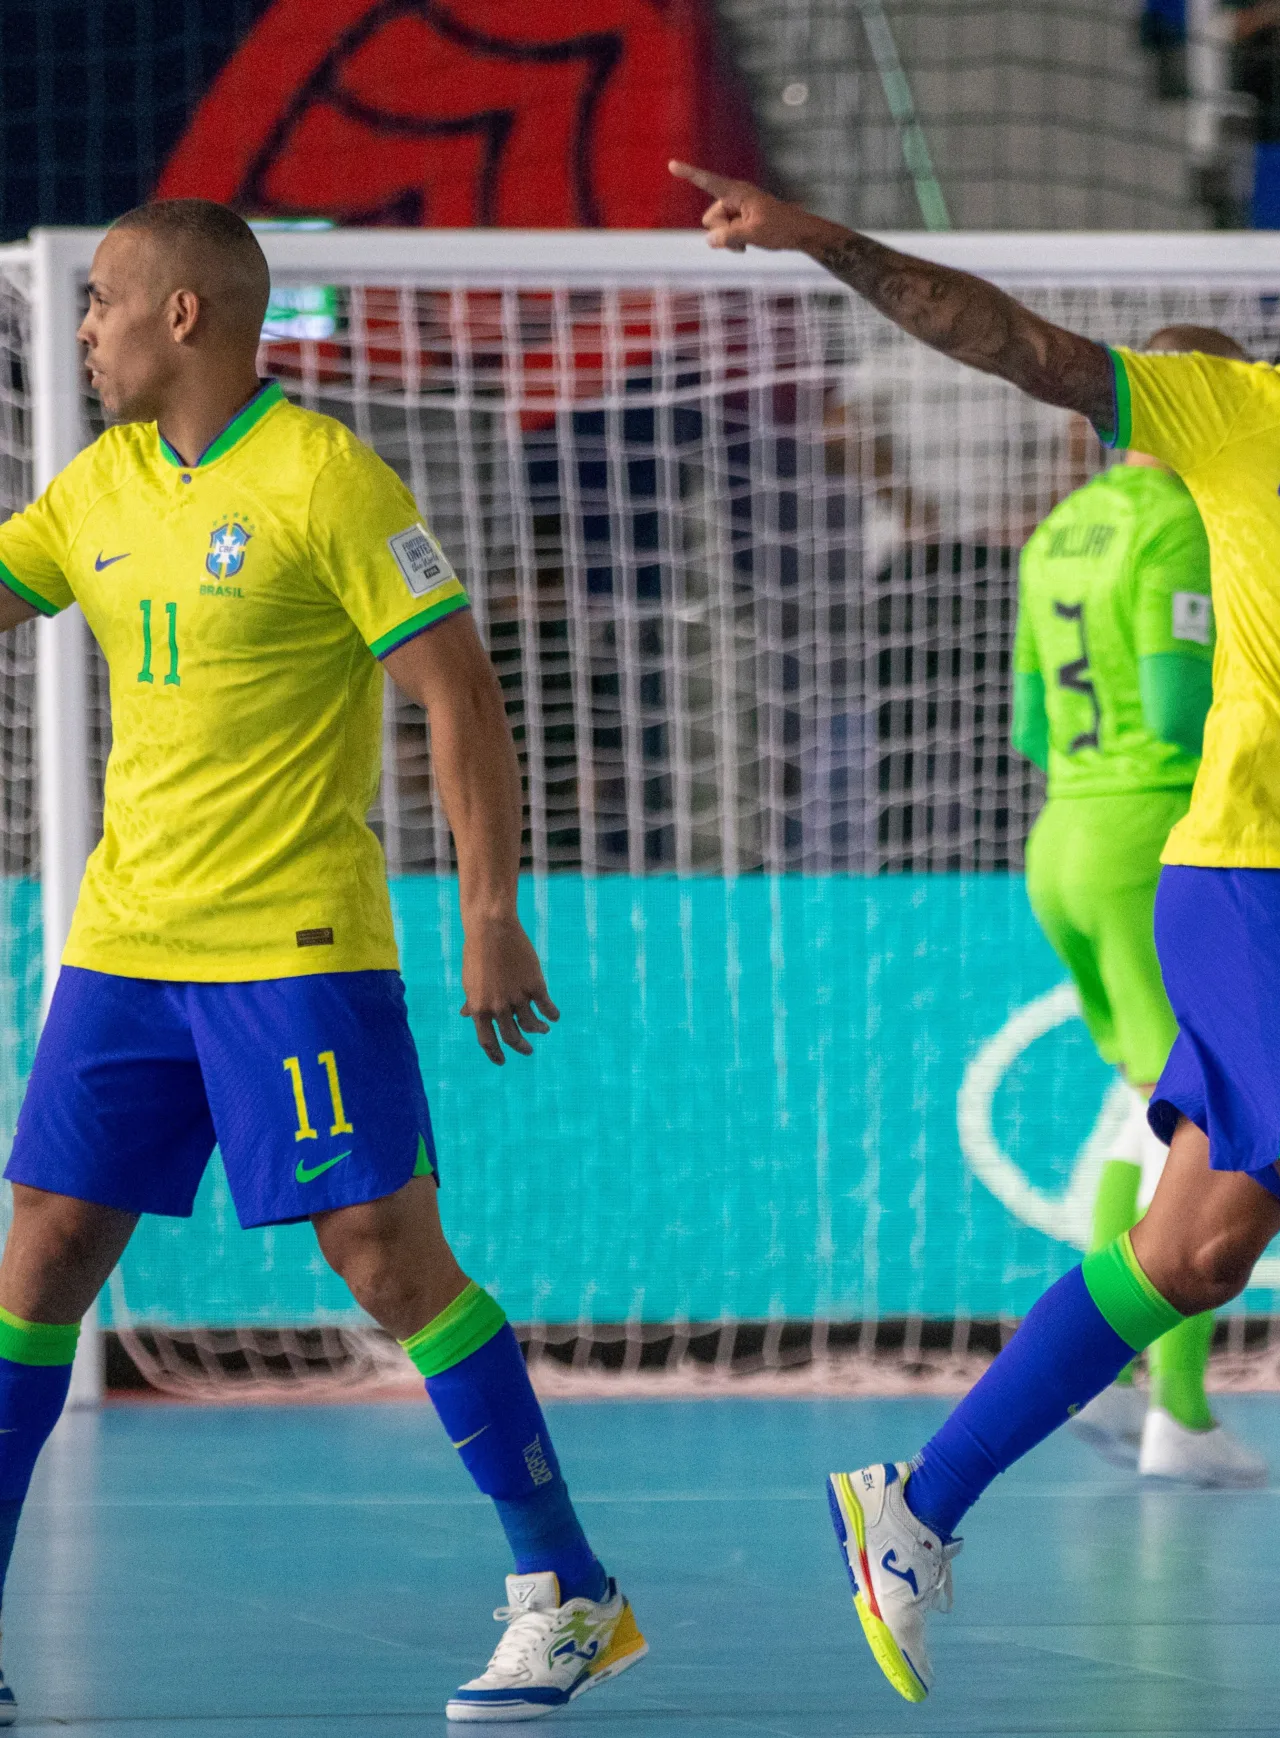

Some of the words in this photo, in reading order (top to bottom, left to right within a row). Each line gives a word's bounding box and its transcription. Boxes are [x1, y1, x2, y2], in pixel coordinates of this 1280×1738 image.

[200, 583, 245, 599] BRASIL
[137, 599, 181, 687] 11
[1054, 600, 1103, 755] 3
[283, 1050, 354, 1143] 11
